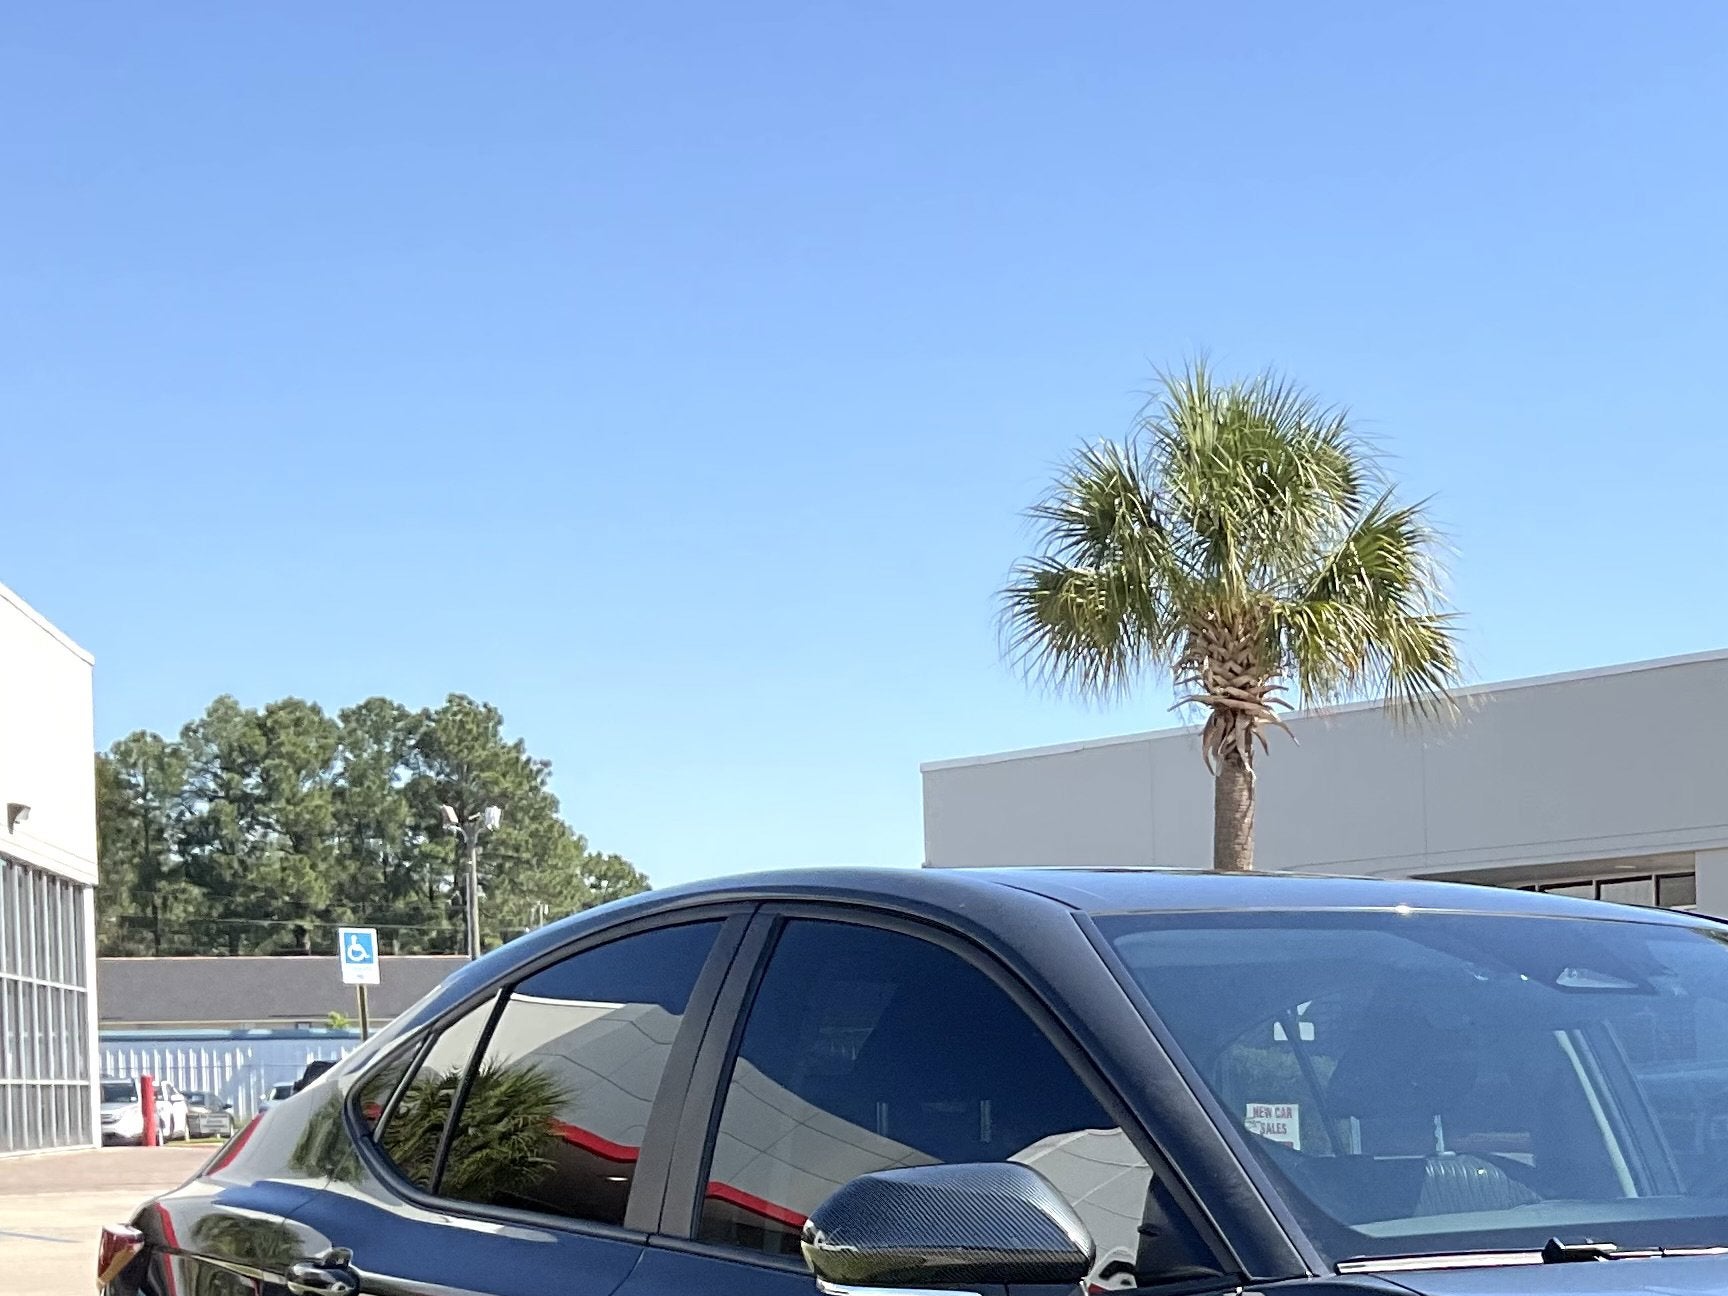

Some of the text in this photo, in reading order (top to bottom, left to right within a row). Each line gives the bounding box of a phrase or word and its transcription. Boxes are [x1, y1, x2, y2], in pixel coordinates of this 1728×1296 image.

[1252, 1106, 1293, 1119] NEW CAR
[1260, 1122, 1288, 1135] SALES
